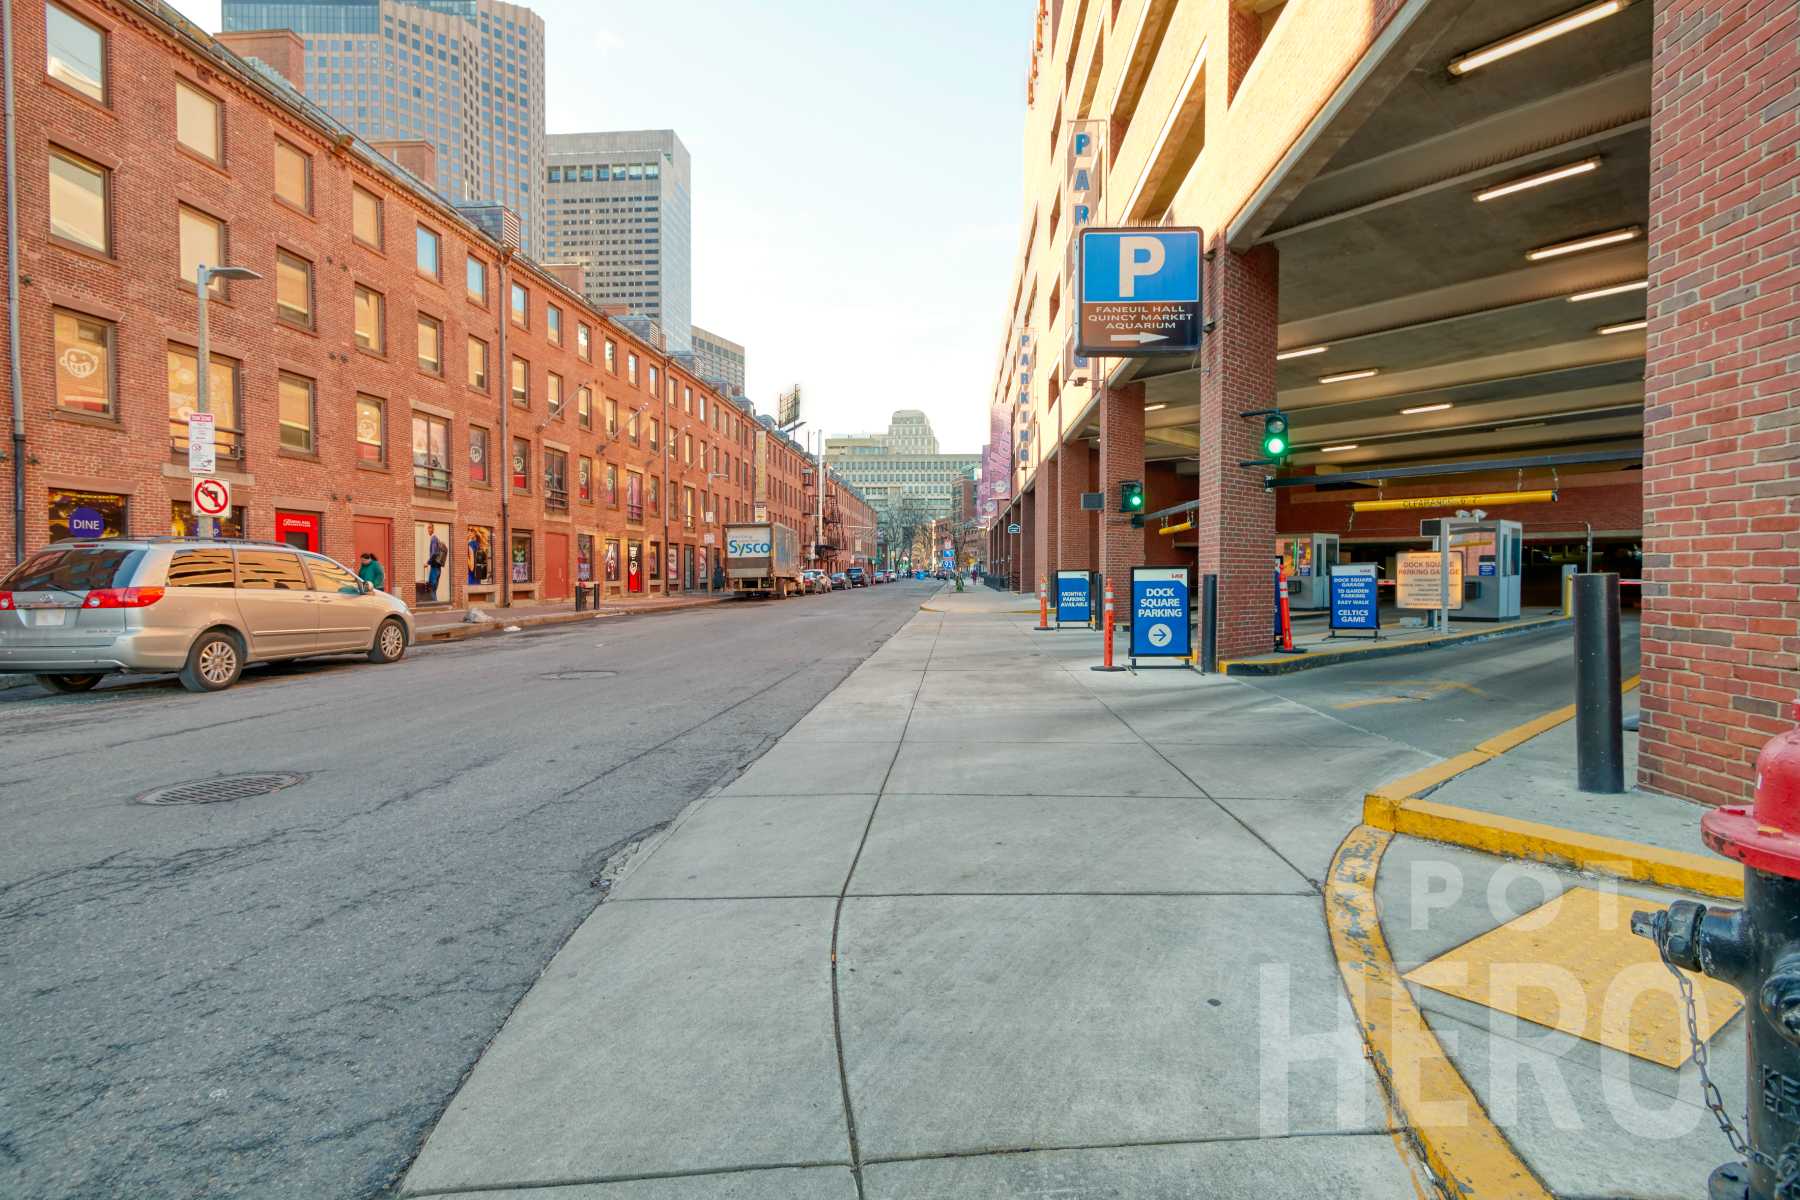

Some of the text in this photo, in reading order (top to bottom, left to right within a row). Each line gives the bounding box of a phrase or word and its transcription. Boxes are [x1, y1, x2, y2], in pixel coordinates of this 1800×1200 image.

[1119, 236, 1166, 298] P
[1095, 305, 1185, 313] FANEUIL HALL
[1087, 313, 1193, 322] QUINCY MARKET
[1105, 321, 1176, 330] AQUARIUM
[1019, 335, 1030, 462] PARKING
[73, 519, 100, 530] DINE
[729, 539, 771, 556] Sysco
[944, 560, 953, 568] 93
[1146, 588, 1175, 597] DOCK
[1140, 598, 1180, 608] SQUARE
[1138, 608, 1183, 618] PARKING
